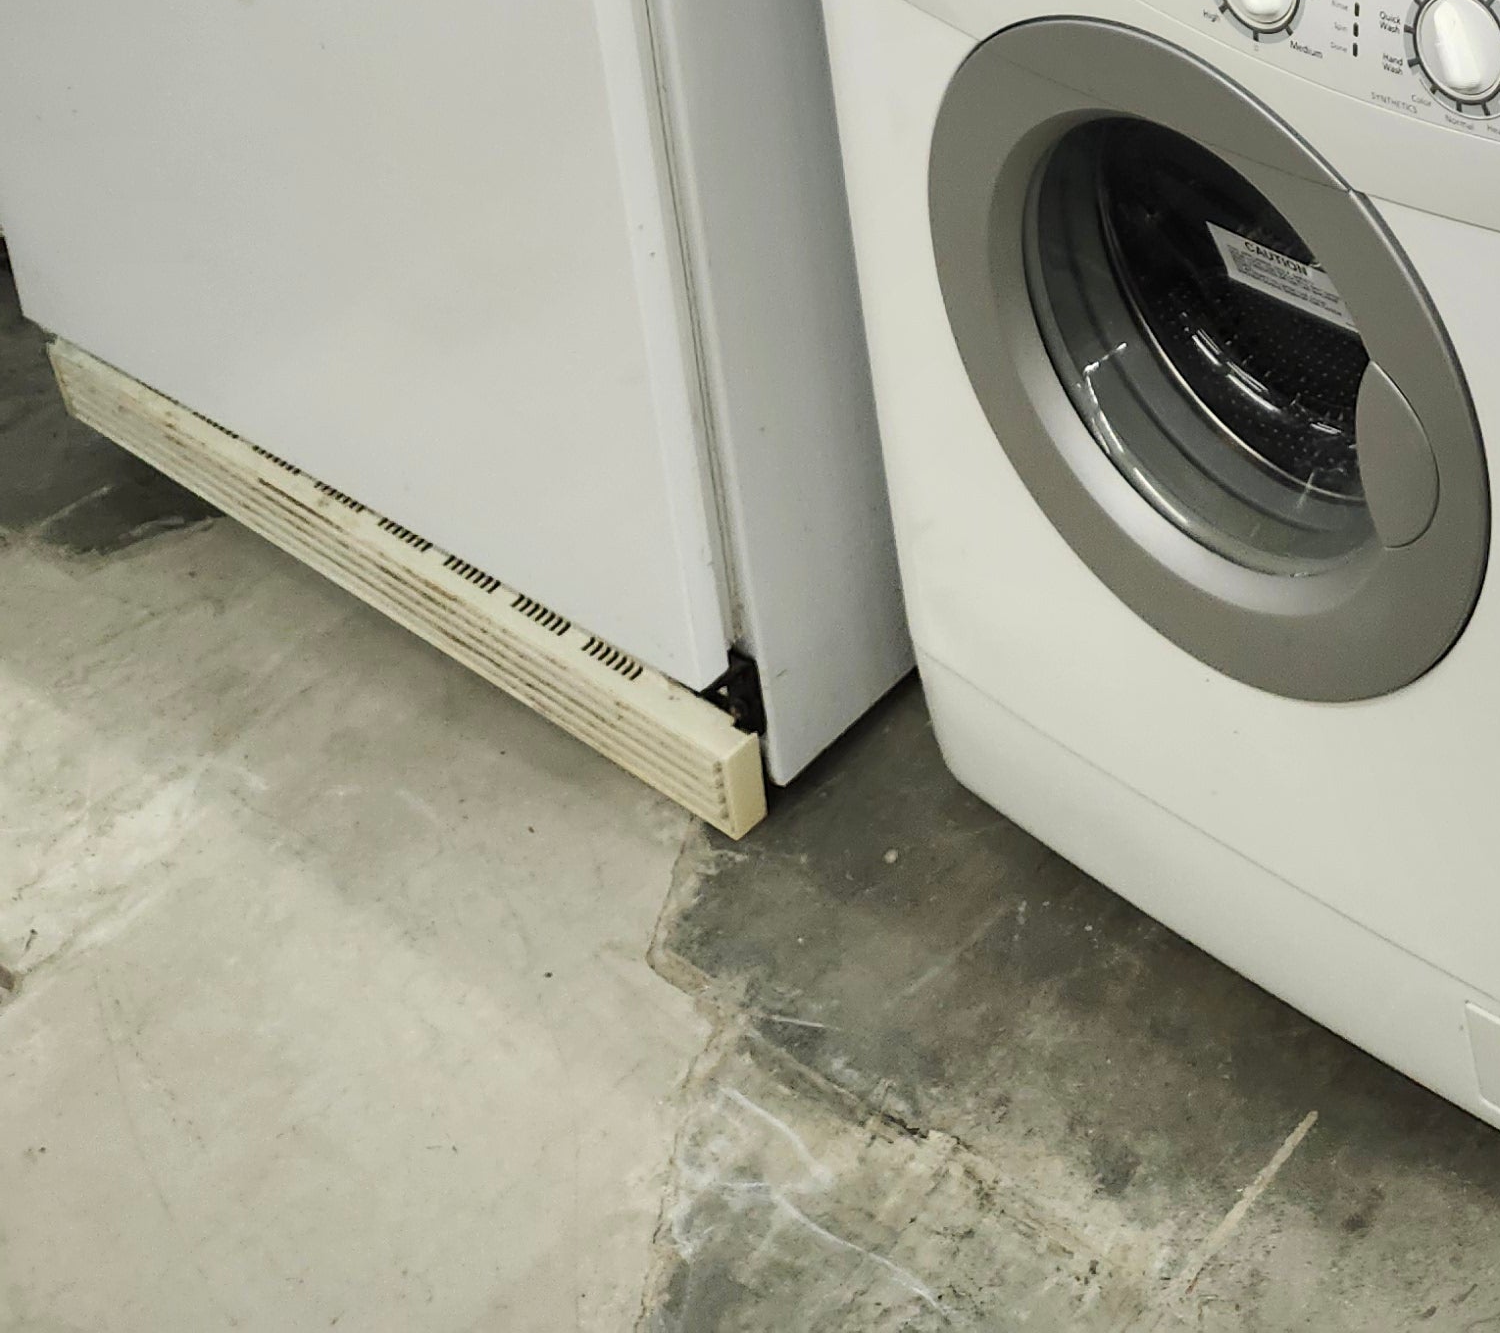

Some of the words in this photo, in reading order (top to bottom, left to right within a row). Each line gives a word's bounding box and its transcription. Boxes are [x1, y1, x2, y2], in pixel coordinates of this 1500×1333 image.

[1203, 9, 1221, 23] High
[1379, 10, 1402, 25] Quick
[1379, 21, 1401, 34] Wash
[1289, 40, 1324, 60] Medium
[1382, 53, 1404, 67] Hand
[1382, 63, 1403, 76] Wash
[1370, 91, 1418, 115] SYNTHETICS
[1411, 94, 1432, 108] Color
[1444, 114, 1475, 132] Normal
[1244, 241, 1309, 277] CAUTION
